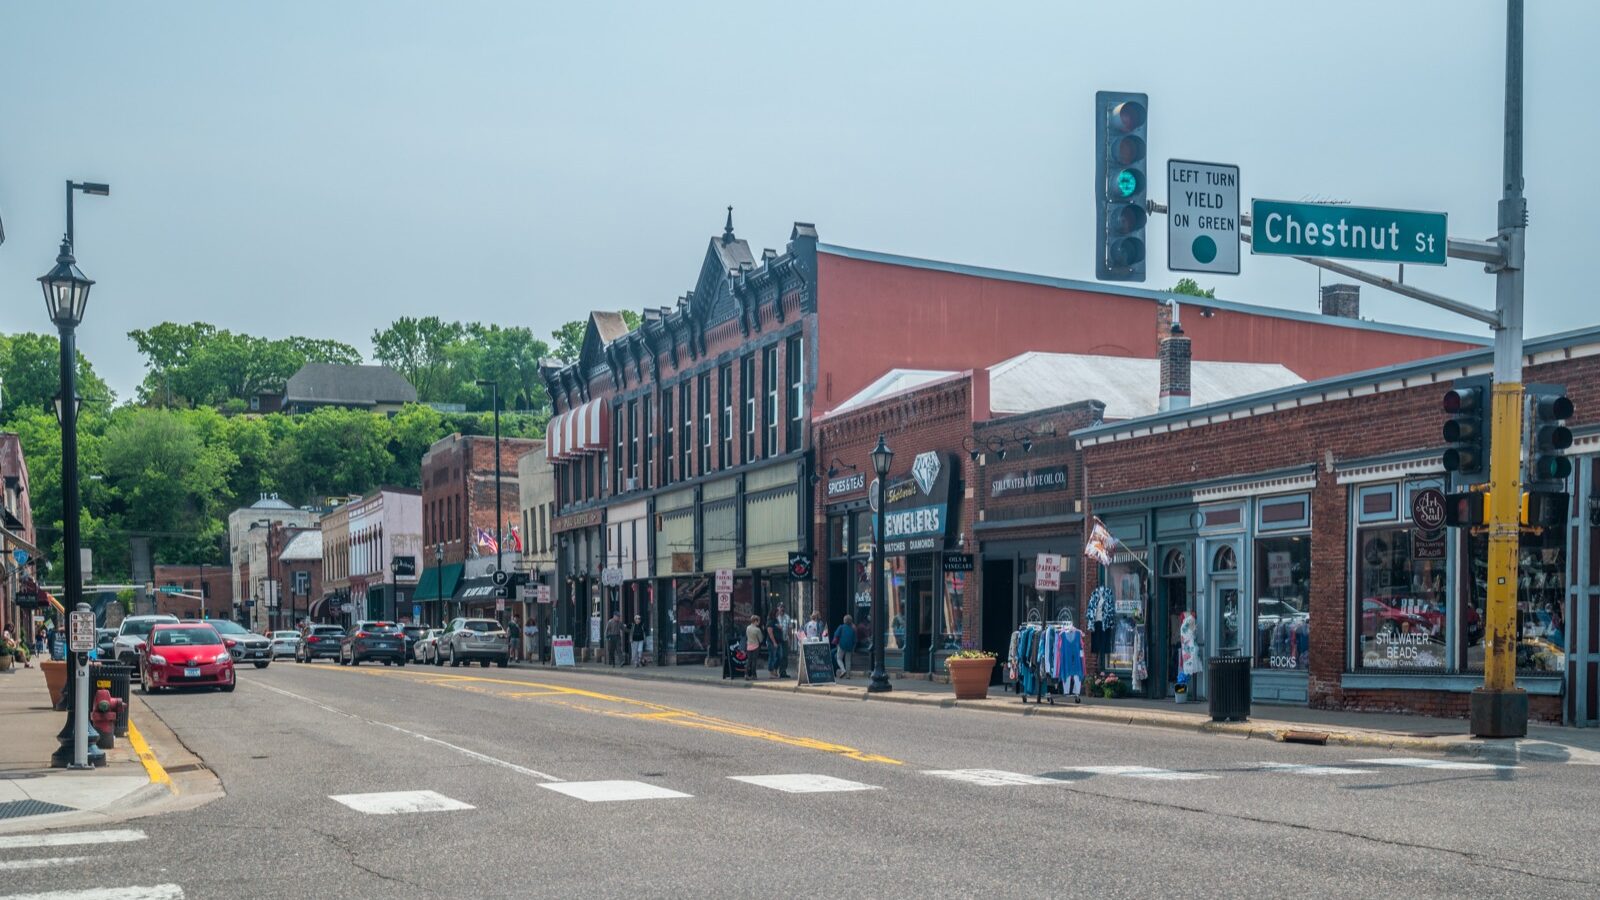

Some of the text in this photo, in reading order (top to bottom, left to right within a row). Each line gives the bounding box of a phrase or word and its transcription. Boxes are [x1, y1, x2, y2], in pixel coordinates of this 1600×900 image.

[1172, 168, 1236, 187] LEFT TURN
[1185, 191, 1224, 209] YIELD
[1173, 213, 1235, 232] ON GREEN
[1264, 212, 1436, 254] Chestnut St
[828, 477, 846, 495] SPICES
[850, 475, 864, 490] TEAS
[992, 477, 1024, 492] STILLWATER
[1025, 474, 1044, 487] OLIVE
[1043, 473, 1055, 485] OIL
[1416, 492, 1438, 511] Art
[1420, 505, 1441, 521] Soul
[886, 508, 940, 537] EWELERS
[909, 538, 935, 551] DIAMONDS
[944, 562, 973, 570] VINEGARS
[1037, 563, 1060, 572] PARKING
[1045, 557, 1053, 565] NO
[496, 573, 505, 583] P
[1038, 579, 1058, 588] STOPPING
[1386, 646, 1418, 659] BEADS
[1270, 655, 1297, 669] ROCKS
